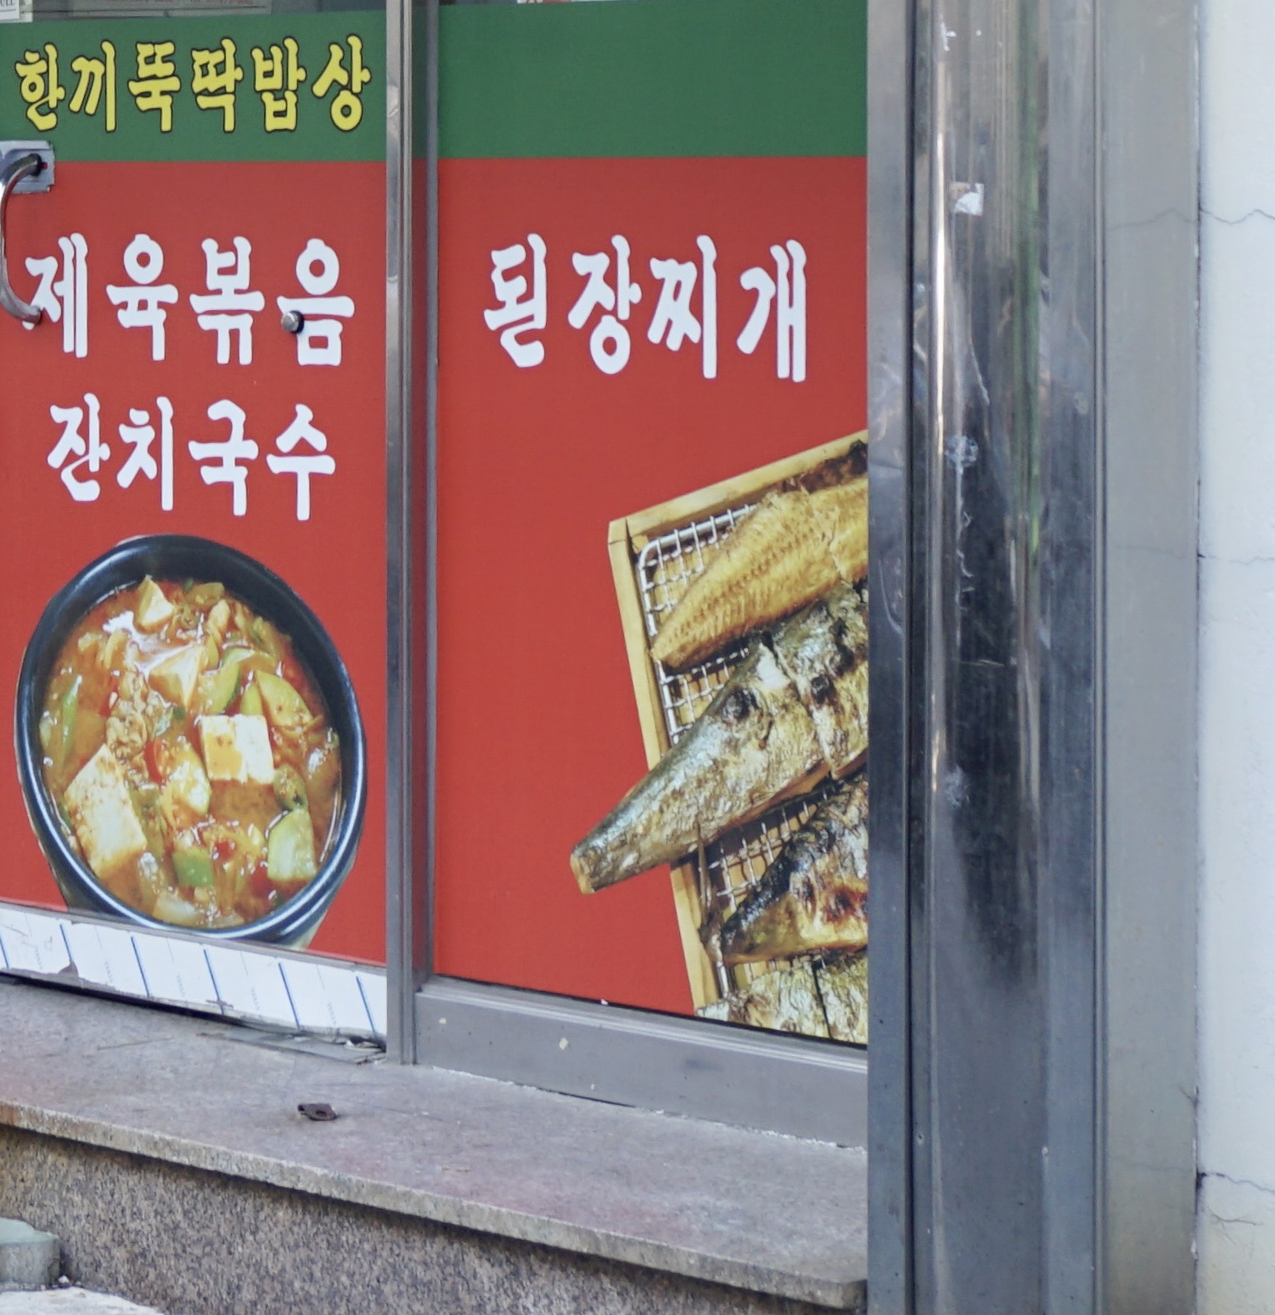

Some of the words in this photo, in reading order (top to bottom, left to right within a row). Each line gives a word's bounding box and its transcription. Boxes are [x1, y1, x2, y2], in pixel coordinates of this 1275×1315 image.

[22, 232, 356, 368] 제육볶음
[484, 232, 809, 383] 된장찌개
[47, 391, 338, 523] 잔치국수
